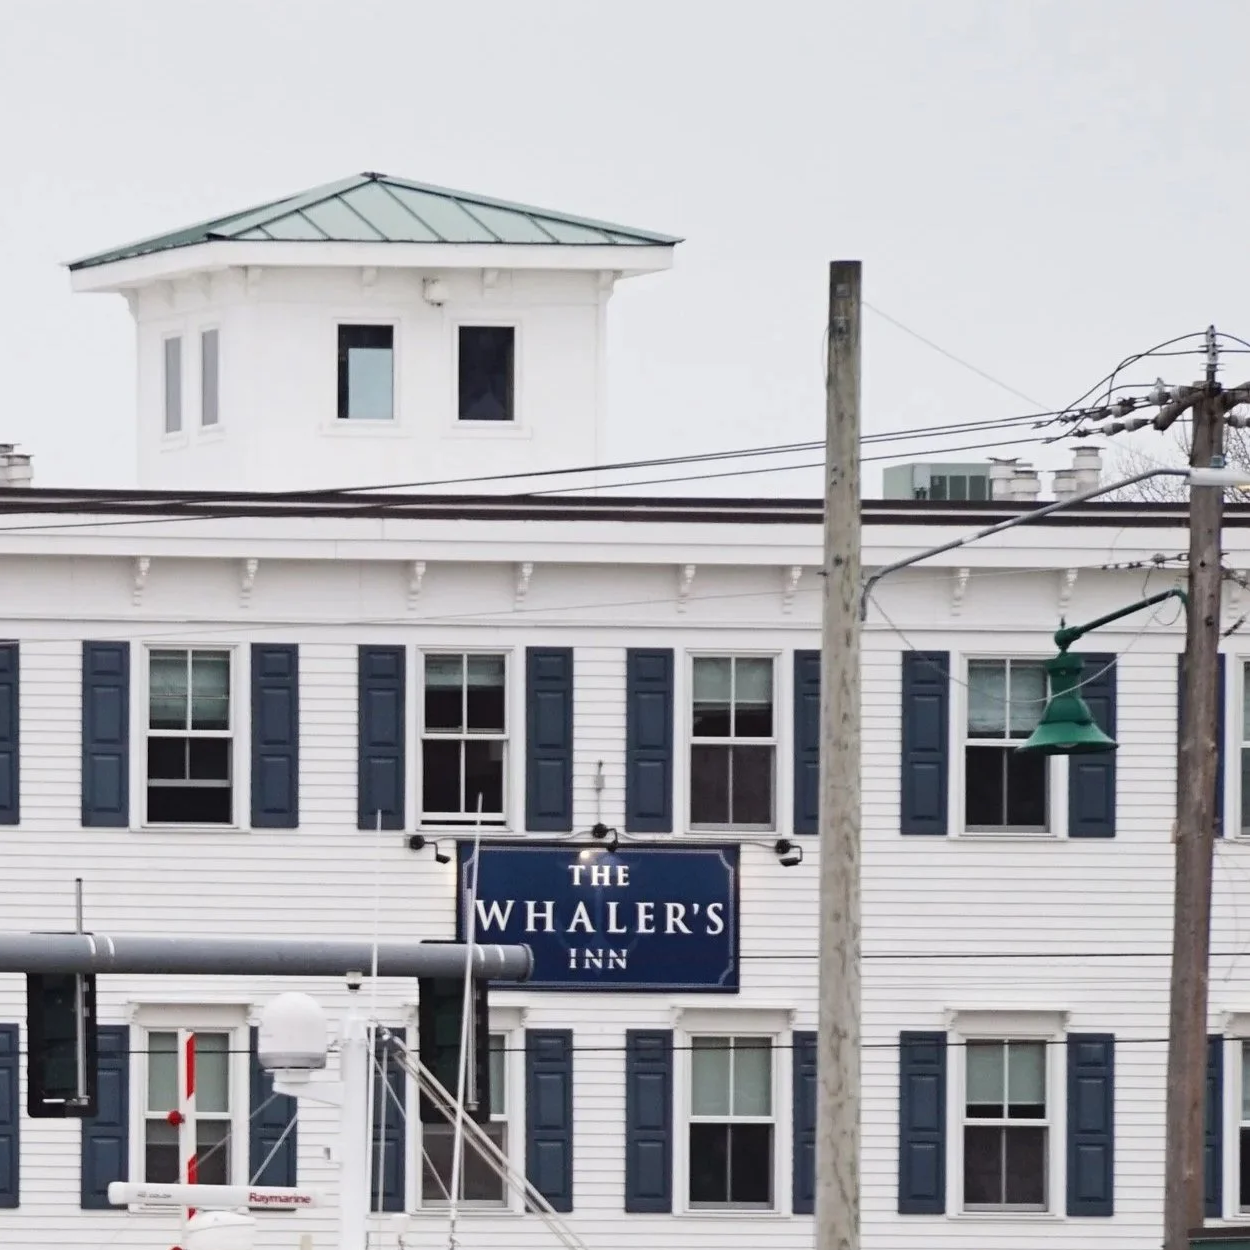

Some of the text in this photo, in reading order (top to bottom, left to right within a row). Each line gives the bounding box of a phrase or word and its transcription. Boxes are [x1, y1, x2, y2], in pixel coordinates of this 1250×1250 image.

[568, 864, 630, 886] THE
[476, 899, 725, 935] WHALER'S
[568, 948, 628, 970] INN
[249, 1192, 312, 1204] Raymarine
